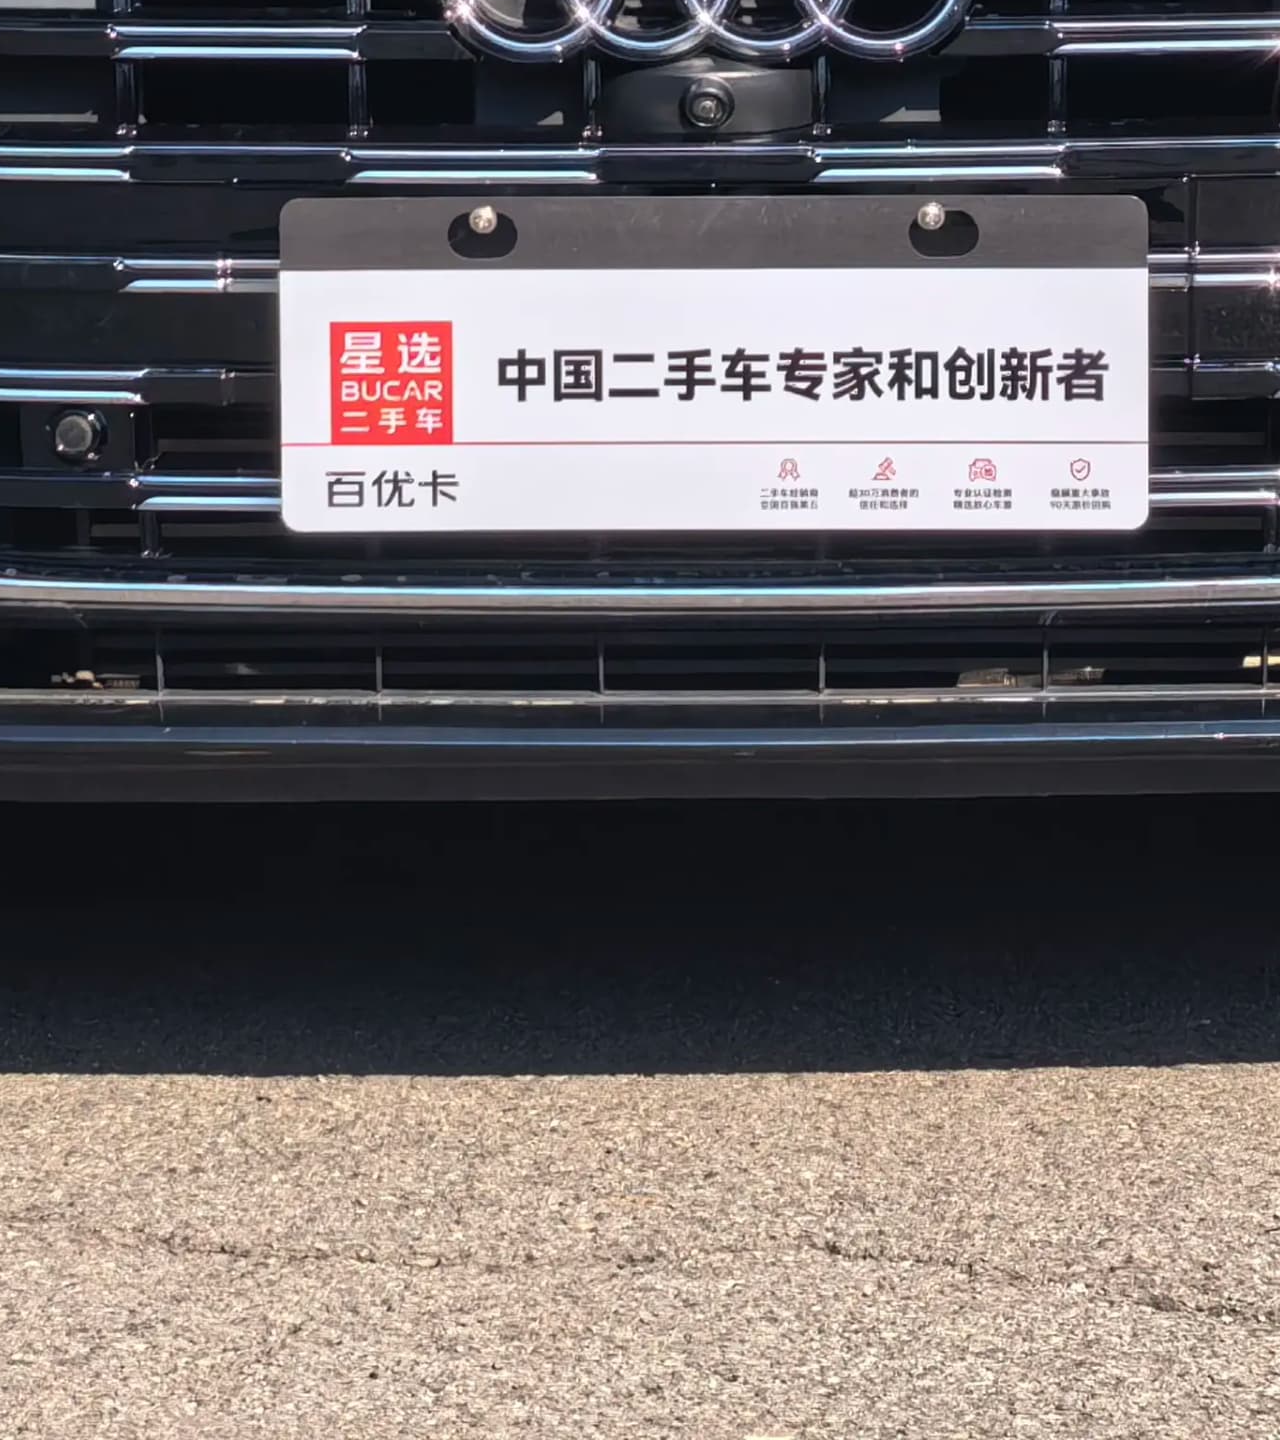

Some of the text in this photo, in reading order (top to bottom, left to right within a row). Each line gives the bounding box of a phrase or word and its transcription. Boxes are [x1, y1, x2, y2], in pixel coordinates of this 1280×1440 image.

[340, 331, 442, 375] 星选
[341, 380, 443, 402] BUCAR
[497, 345, 1110, 403] 中国二手车专家和创新者
[340, 407, 444, 435] 二手车
[325, 469, 459, 509] 百优卡
